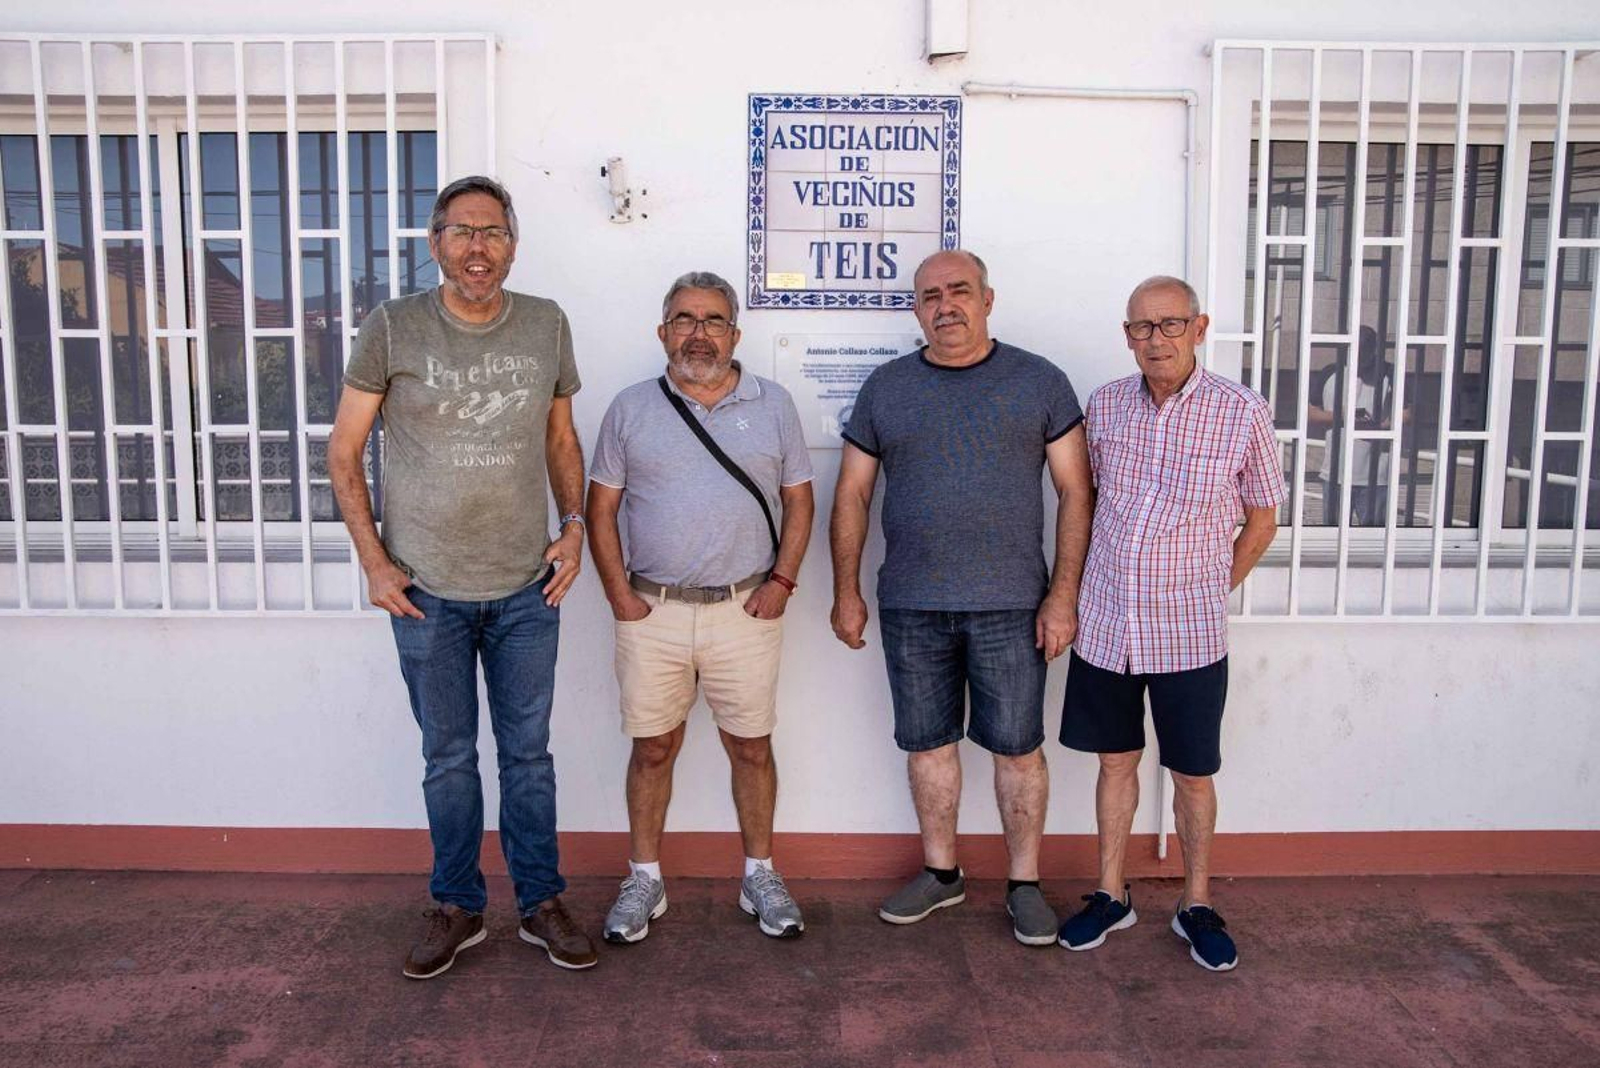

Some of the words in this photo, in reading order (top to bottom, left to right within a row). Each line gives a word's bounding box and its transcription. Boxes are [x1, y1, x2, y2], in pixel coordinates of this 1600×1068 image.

[770, 118, 939, 151] ASOCIACIÓN
[840, 156, 869, 171] DE
[793, 175, 915, 207] VECIÑOS
[839, 212, 868, 228] DE
[809, 241, 897, 279] TEIS
[806, 347, 837, 355] Antonio
[839, 347, 867, 356] Collazo
[869, 347, 898, 355] Collazo
[454, 454, 515, 467] LONDON
